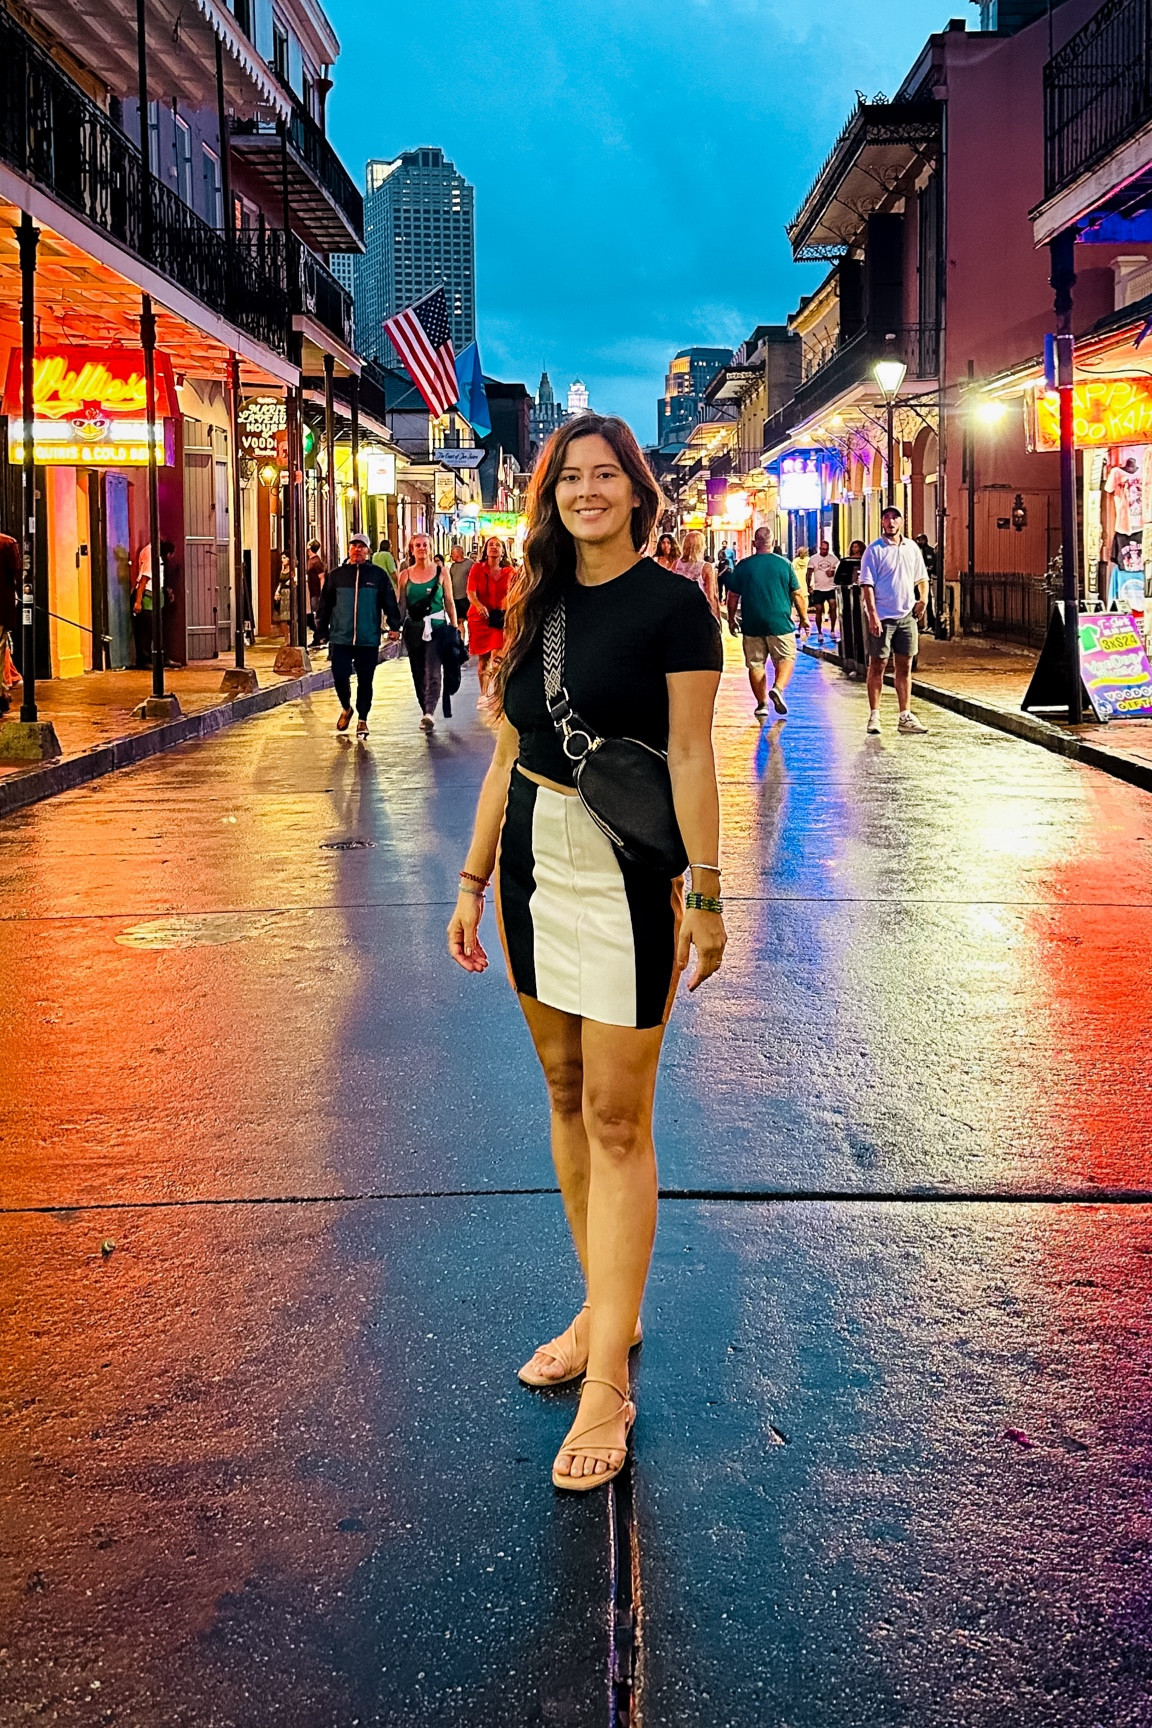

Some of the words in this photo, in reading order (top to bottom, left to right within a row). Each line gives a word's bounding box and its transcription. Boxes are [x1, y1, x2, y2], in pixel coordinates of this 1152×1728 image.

[241, 436, 278, 449] VOOD
[81, 446, 92, 460] &
[93, 446, 126, 460] COLD
[1118, 699, 1152, 711] GIFT
